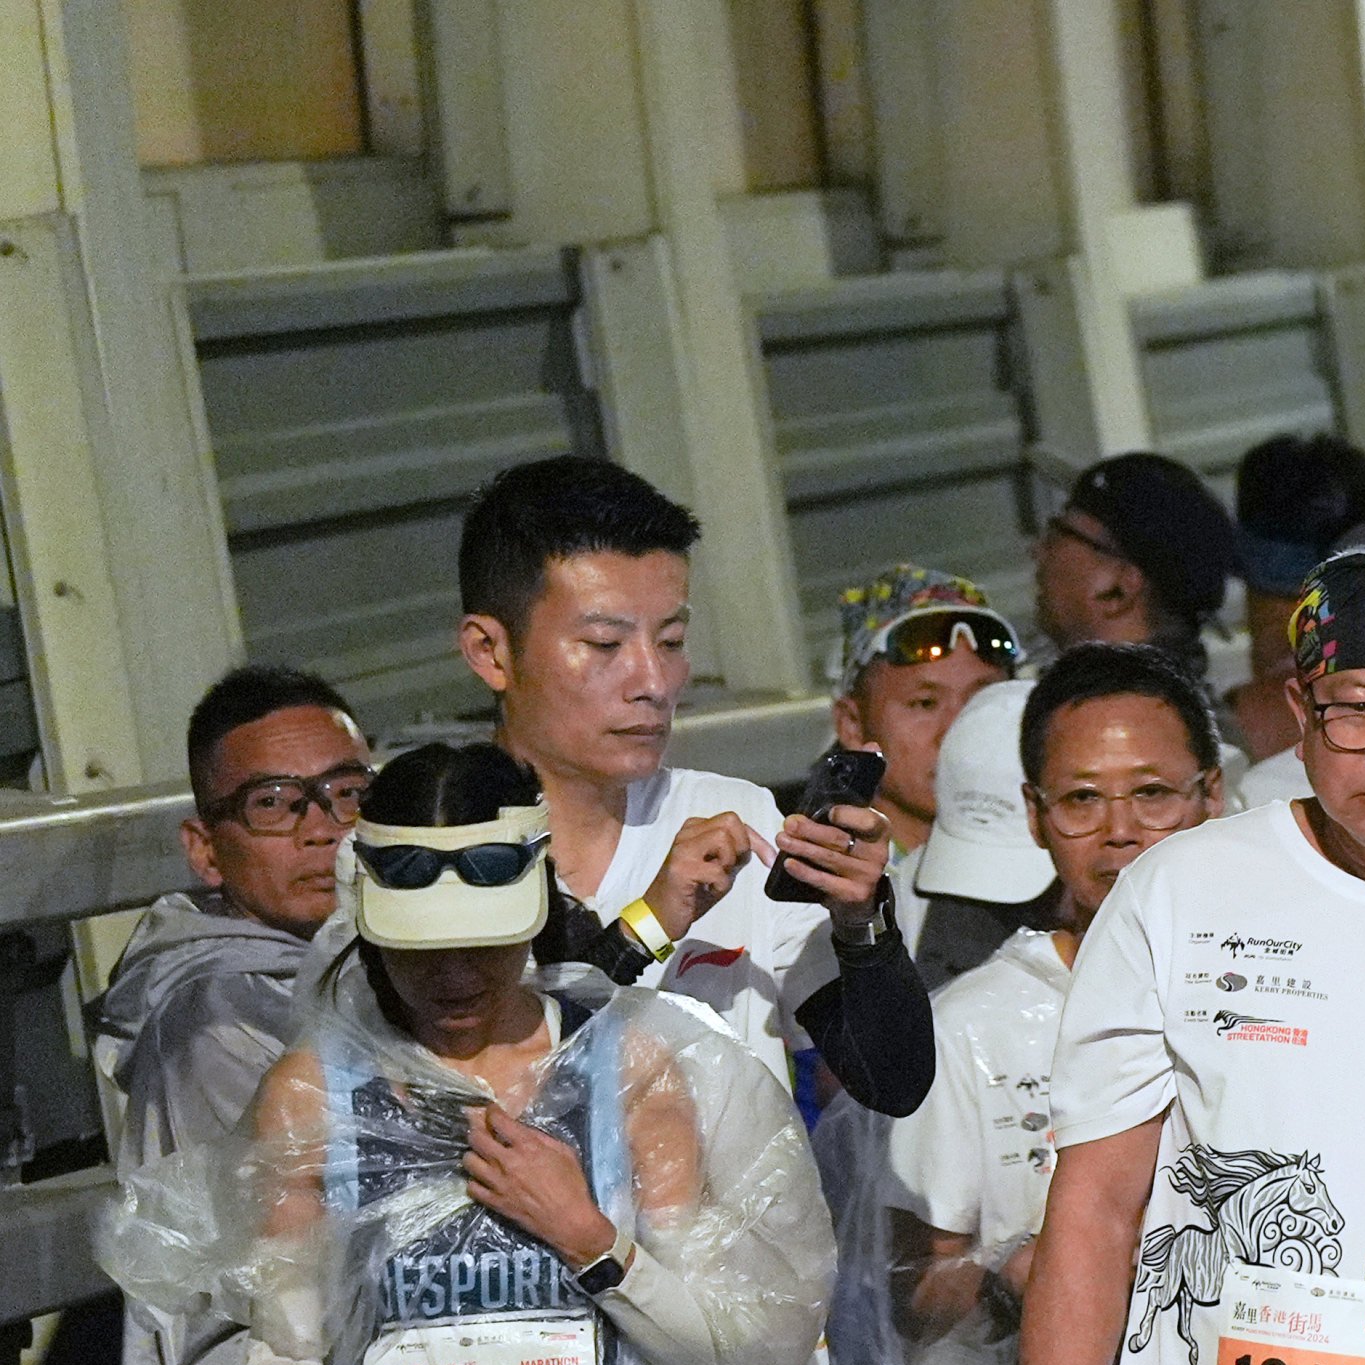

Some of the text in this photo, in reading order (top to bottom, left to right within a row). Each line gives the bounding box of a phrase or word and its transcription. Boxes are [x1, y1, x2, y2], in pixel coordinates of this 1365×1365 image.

[1247, 937, 1303, 951] RunOurCity
[1254, 986, 1329, 1001] KERRY PROPERTIES
[1240, 1024, 1291, 1035] HONGKONG
[1227, 1033, 1290, 1044] STREETATHON
[1233, 1300, 1322, 1334] 嘉里香港街馬
[1307, 1333, 1330, 1344] 2024
